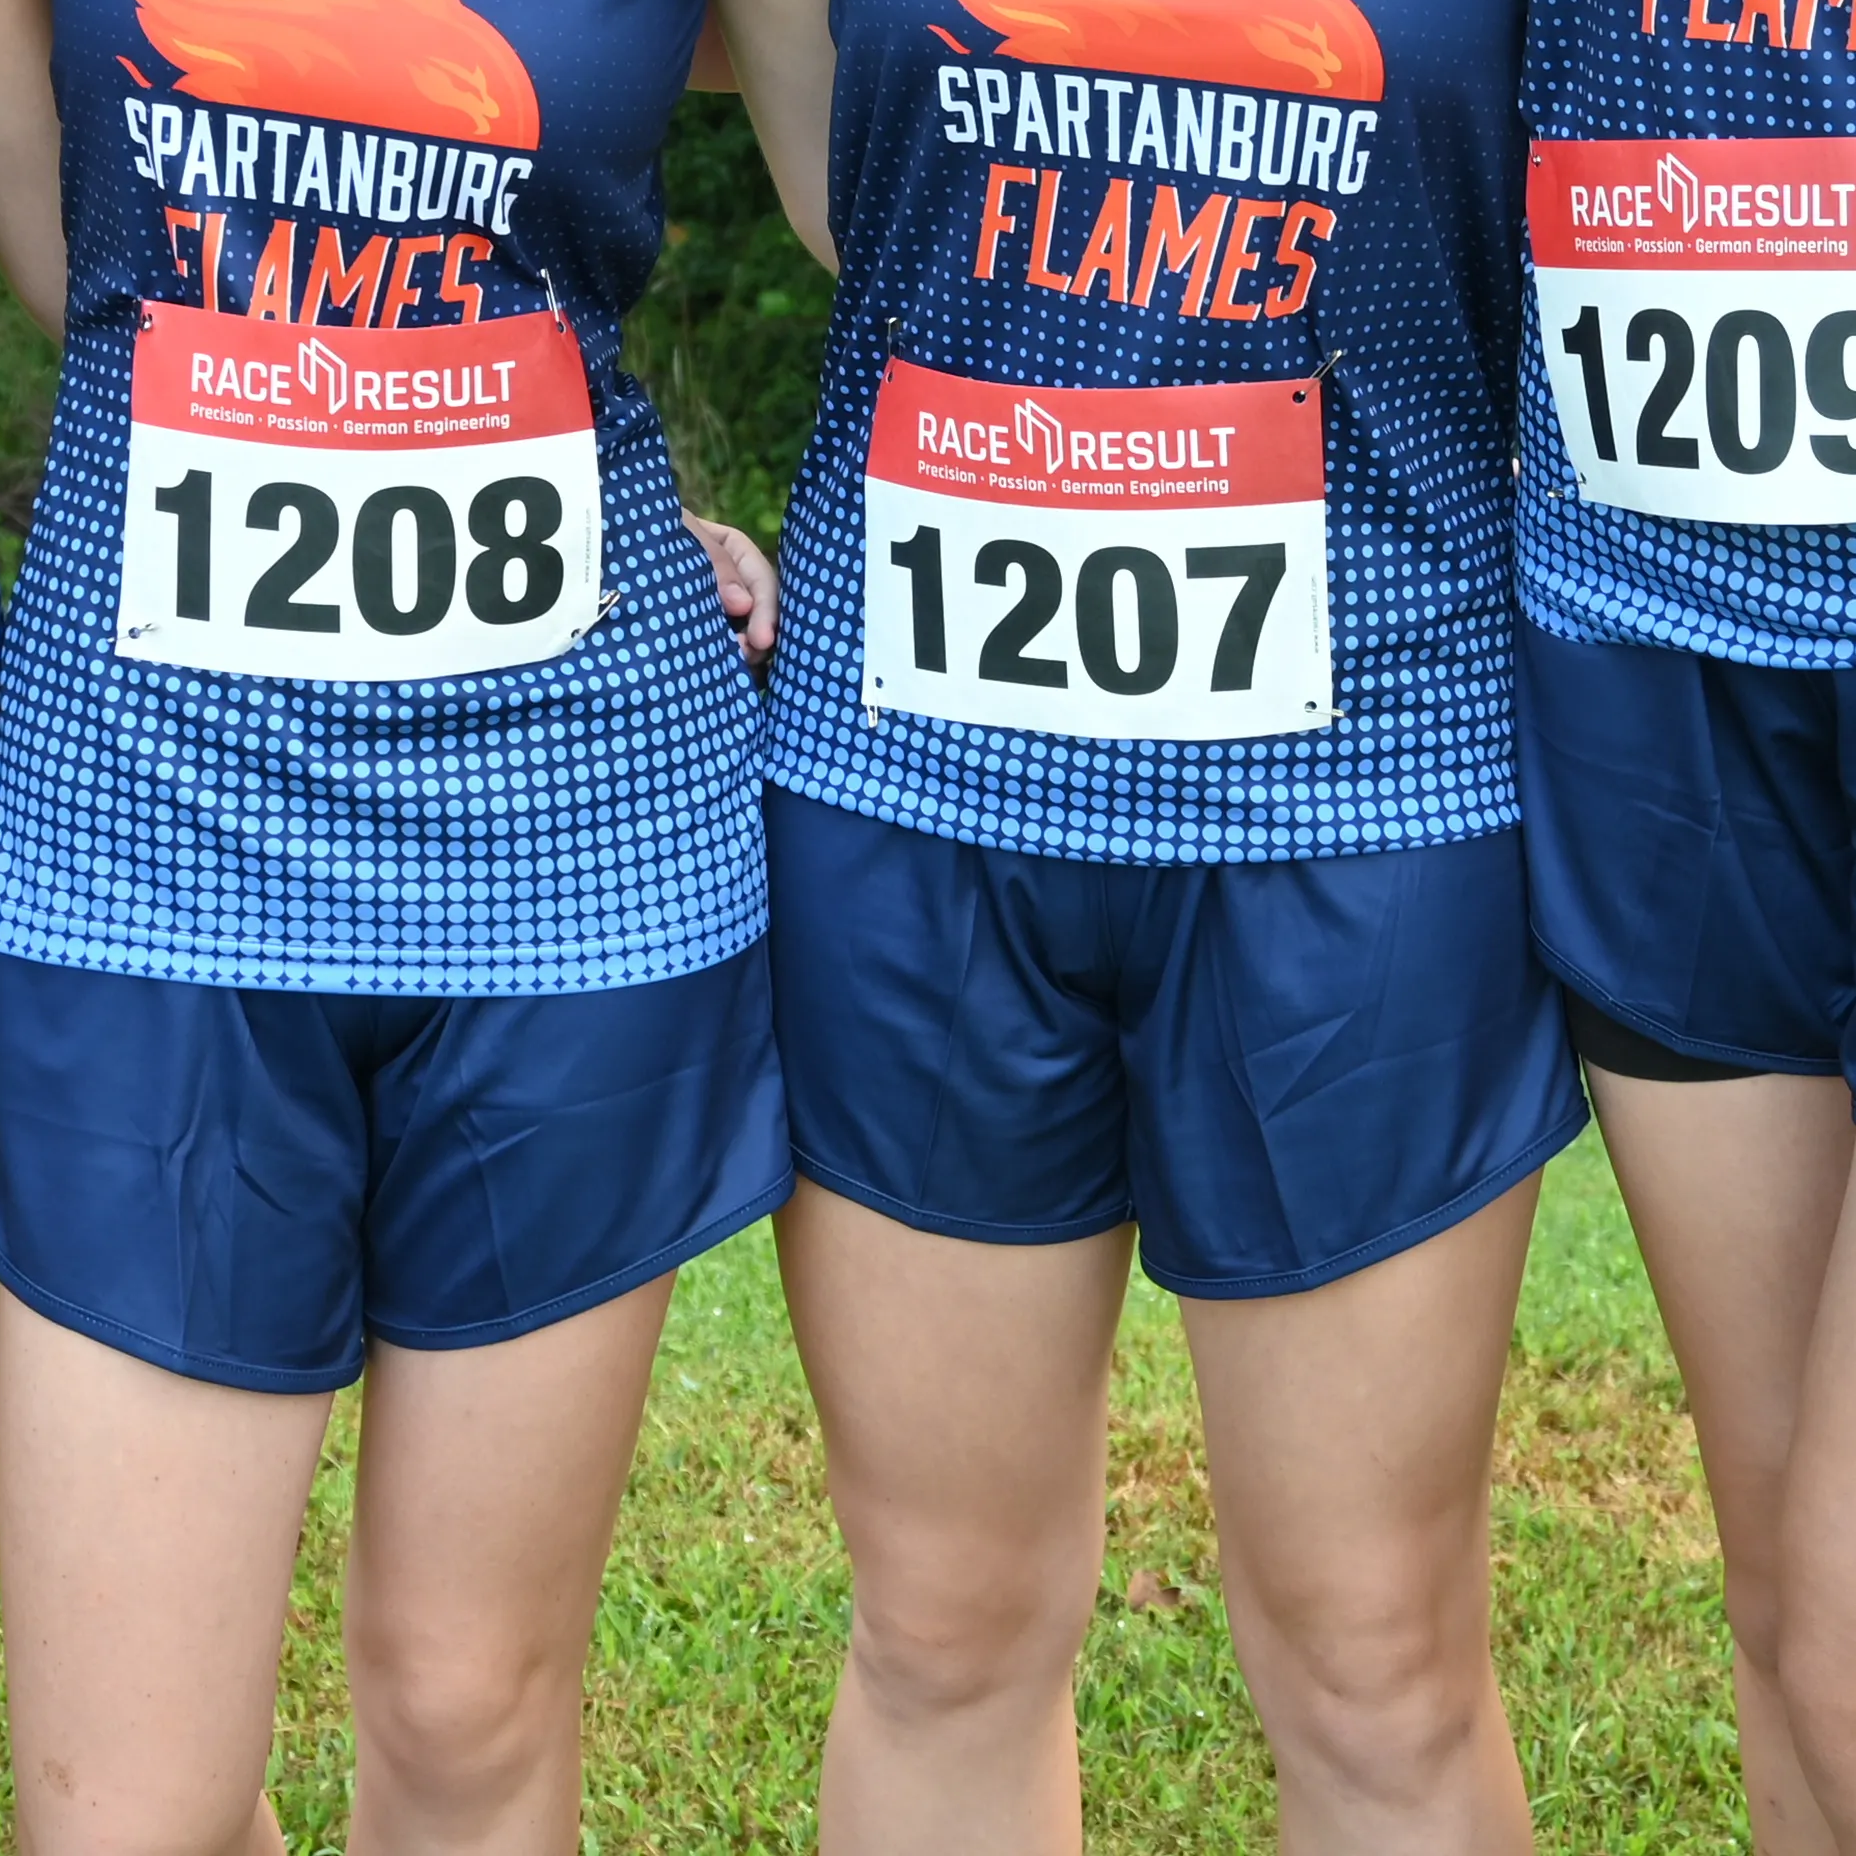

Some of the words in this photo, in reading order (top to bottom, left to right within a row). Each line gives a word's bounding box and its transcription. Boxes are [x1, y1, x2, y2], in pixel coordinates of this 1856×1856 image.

[937, 64, 1379, 195] SPARTANBURG
[124, 96, 533, 235] SPARTANBURG
[1570, 185, 1653, 227] RACE
[1704, 183, 1856, 227] RESULT
[973, 163, 1336, 321] FLAMES
[1575, 237, 1624, 253] Precision
[1635, 237, 1684, 253] Passion
[1696, 237, 1751, 254] German
[1757, 236, 1848, 256] Engineering
[191, 352, 291, 405] RACE
[354, 360, 516, 411] RESULT
[190, 402, 254, 426] Precision
[267, 413, 328, 433] Passion
[343, 419, 408, 435] German
[414, 413, 511, 436] Engineering
[917, 411, 1011, 465] RACE
[1069, 427, 1236, 471] RESULT
[917, 460, 977, 484] Precision
[989, 472, 1047, 492] Passion
[1061, 478, 1124, 495] German
[1130, 477, 1229, 497] Engineering
[155, 468, 564, 636] 1208
[890, 525, 1288, 695] 1207
